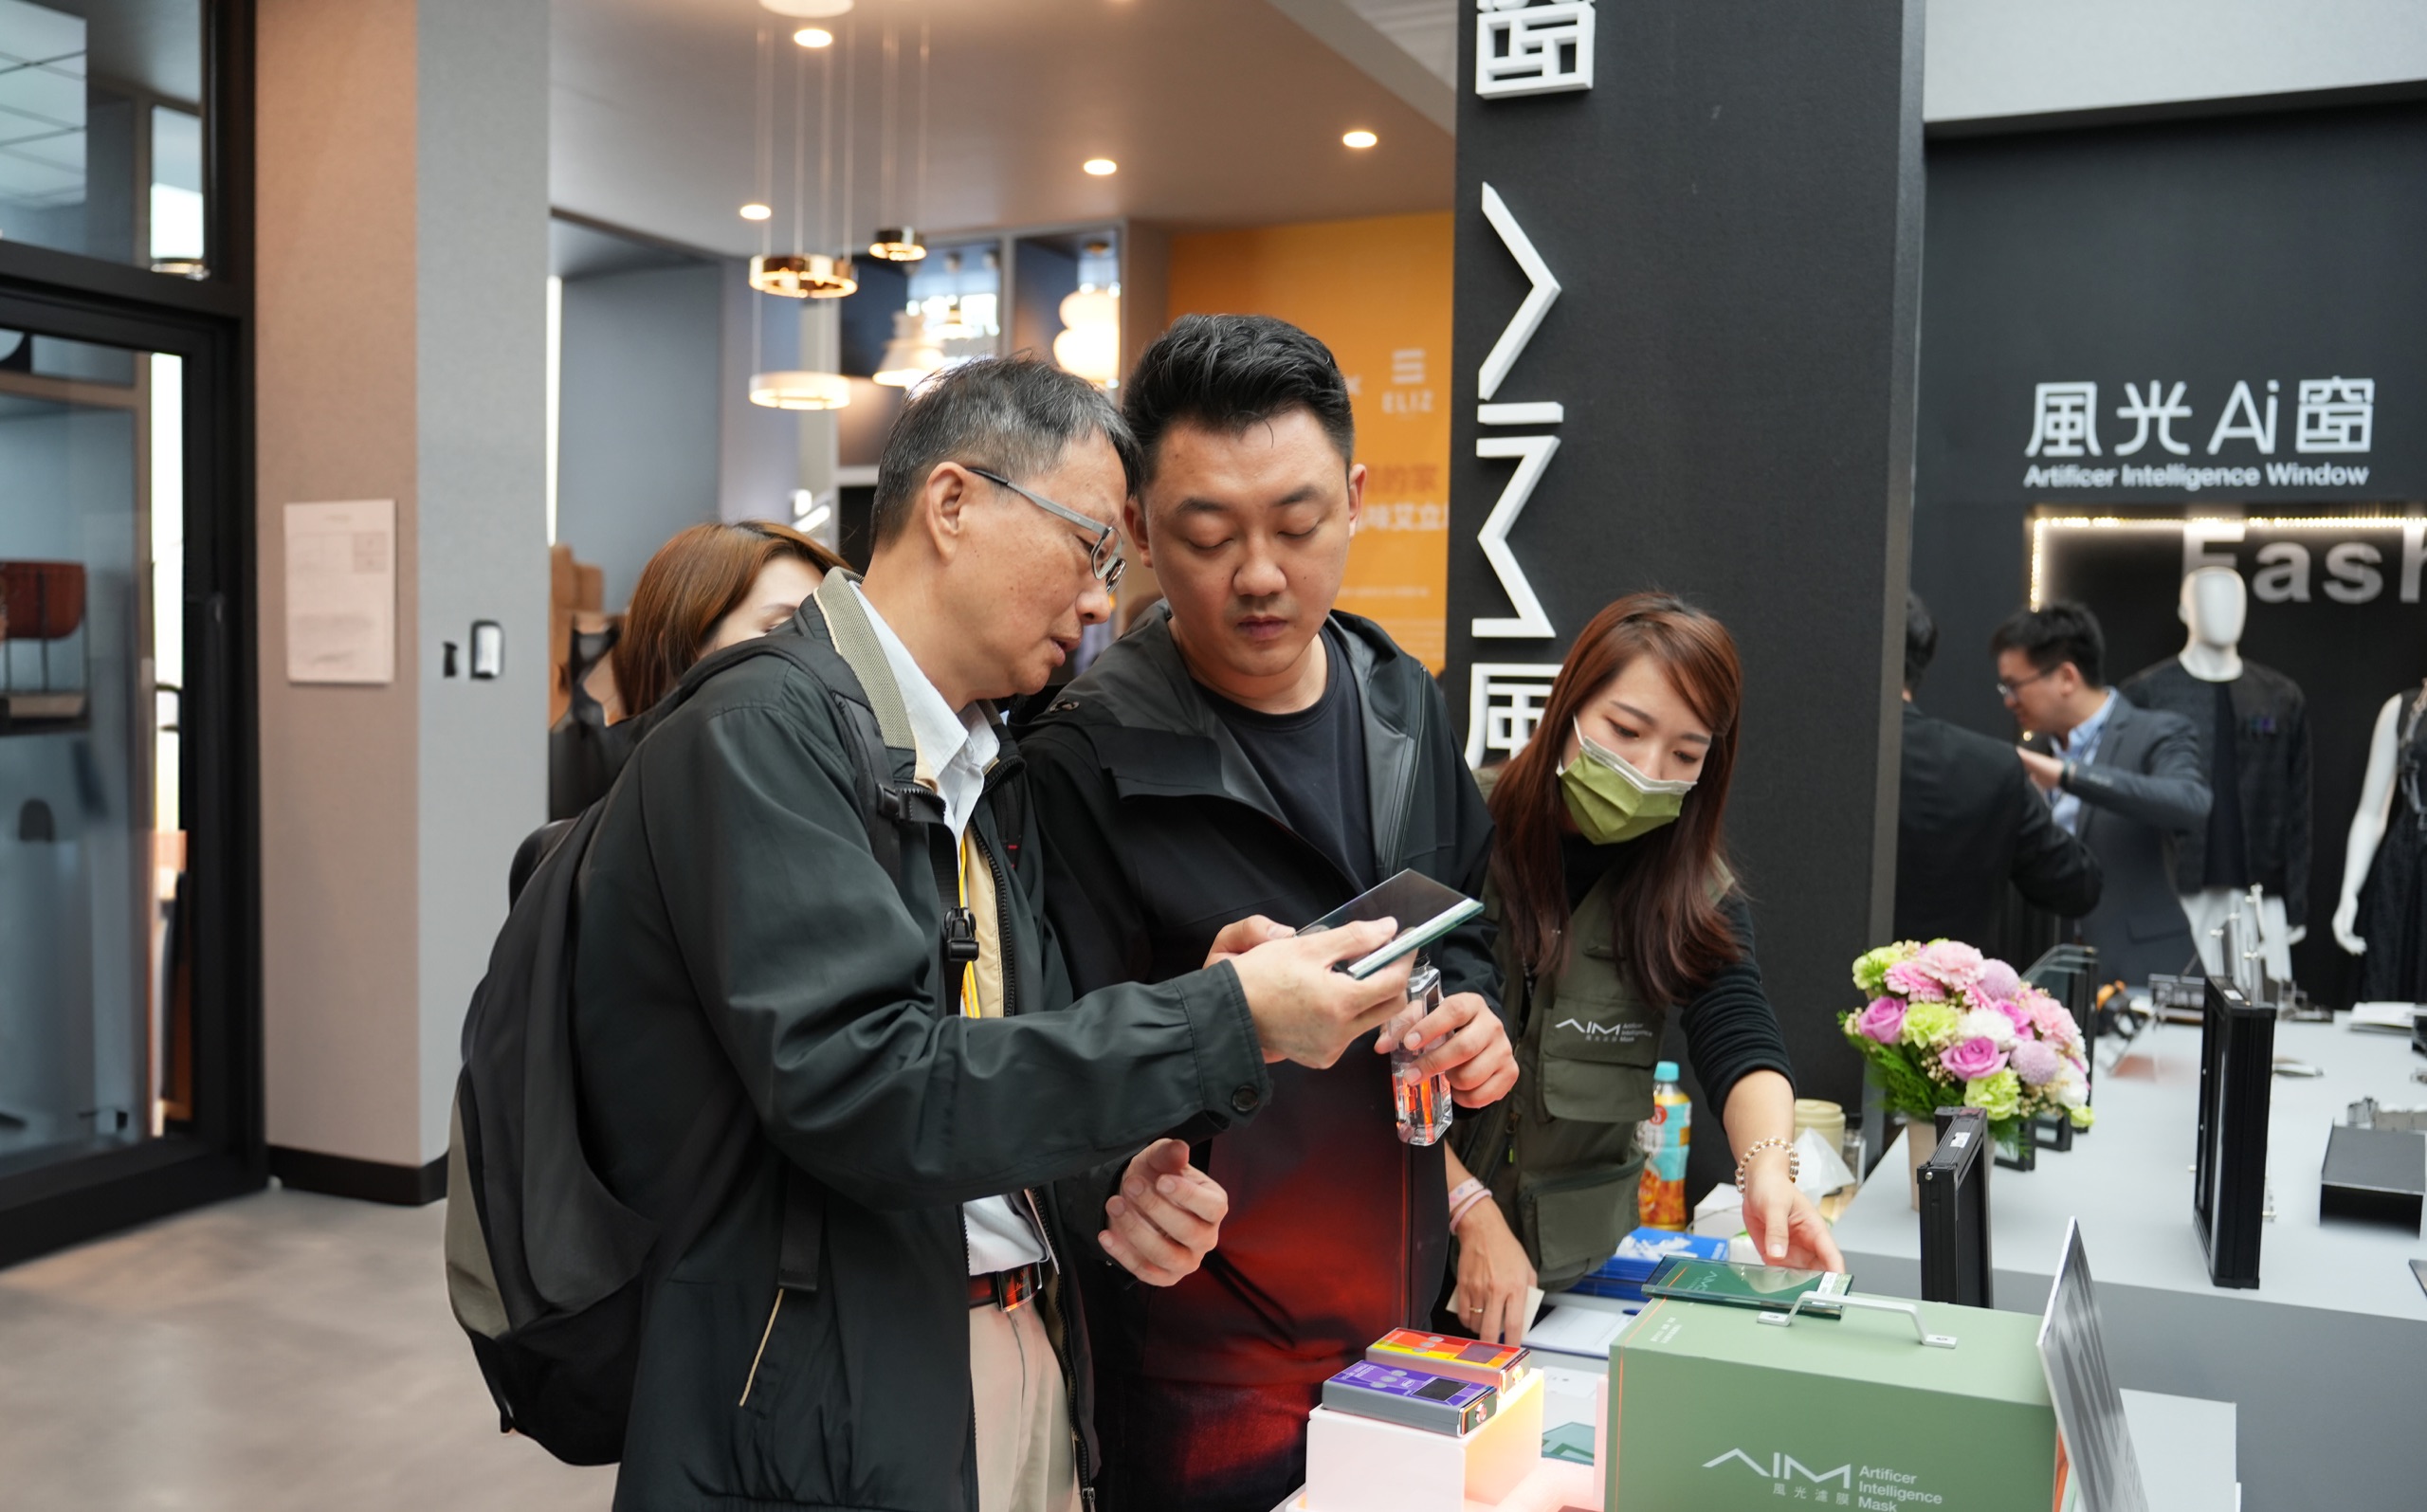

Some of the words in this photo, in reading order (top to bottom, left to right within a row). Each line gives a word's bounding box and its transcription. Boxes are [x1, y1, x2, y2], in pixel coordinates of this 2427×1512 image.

[2023, 464, 2118, 487] Artificer
[2121, 464, 2260, 491] Intelligence
[2266, 462, 2370, 486] Window
[1702, 1448, 1852, 1489] AIM
[1859, 1465, 1917, 1485] Artificer
[1773, 1483, 1850, 1506] 風光濾膜
[1857, 1496, 1898, 1512] Mask
[1858, 1481, 1943, 1504] Intelligence
